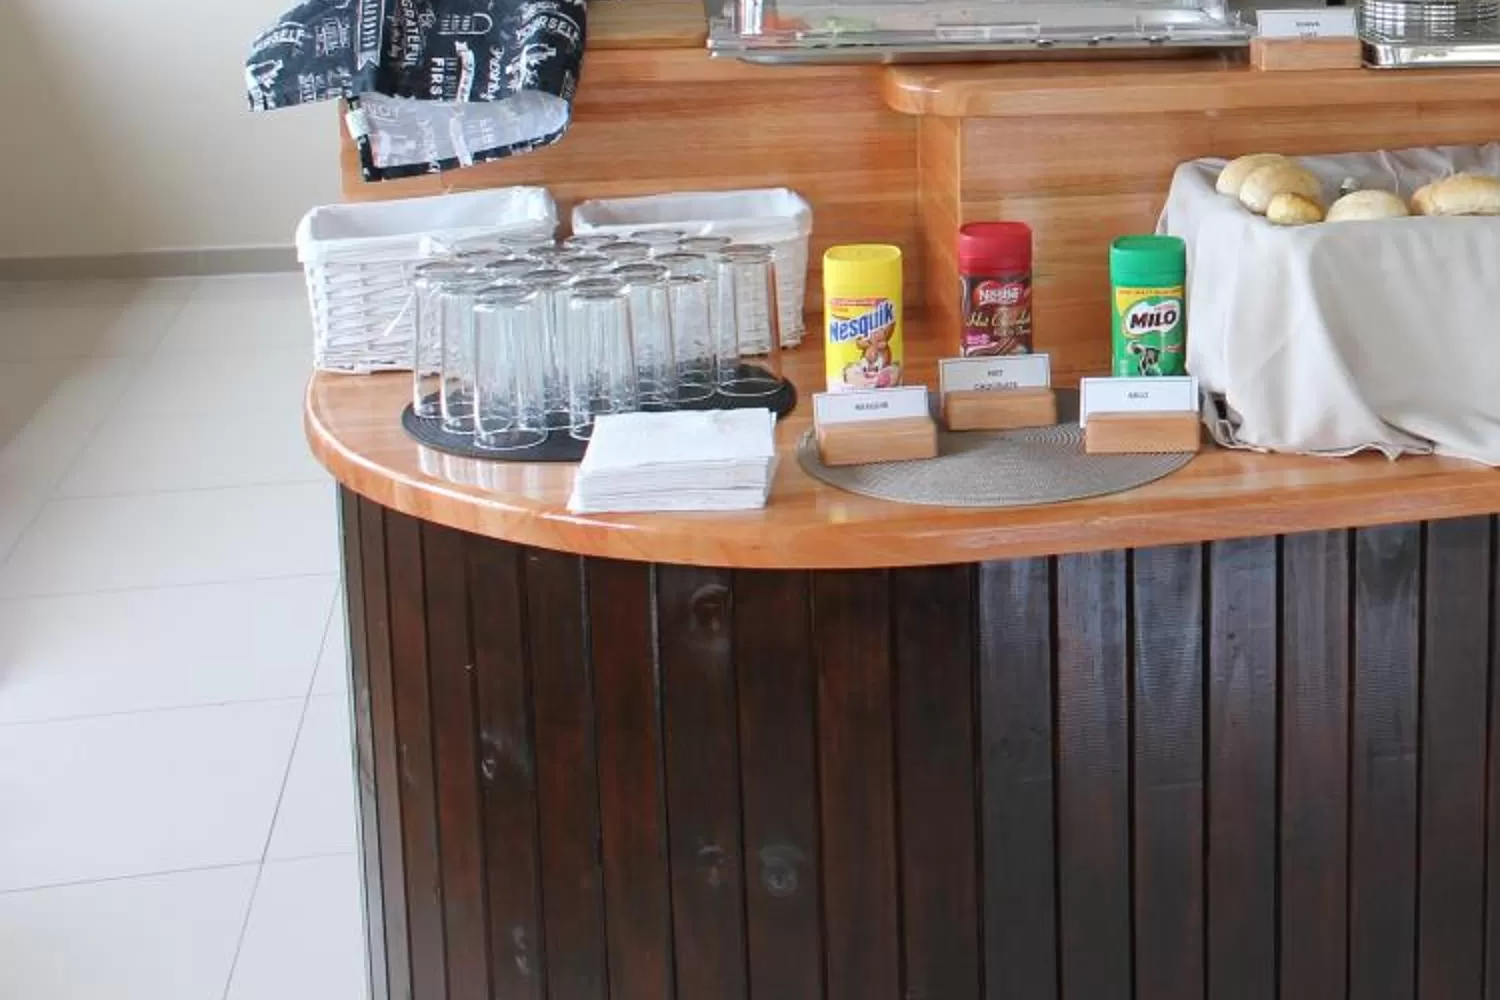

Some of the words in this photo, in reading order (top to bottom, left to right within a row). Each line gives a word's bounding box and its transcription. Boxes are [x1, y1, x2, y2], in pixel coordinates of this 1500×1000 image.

[429, 57, 445, 101] FIRS
[830, 300, 894, 342] Nesquik
[1129, 309, 1177, 329] MILO
